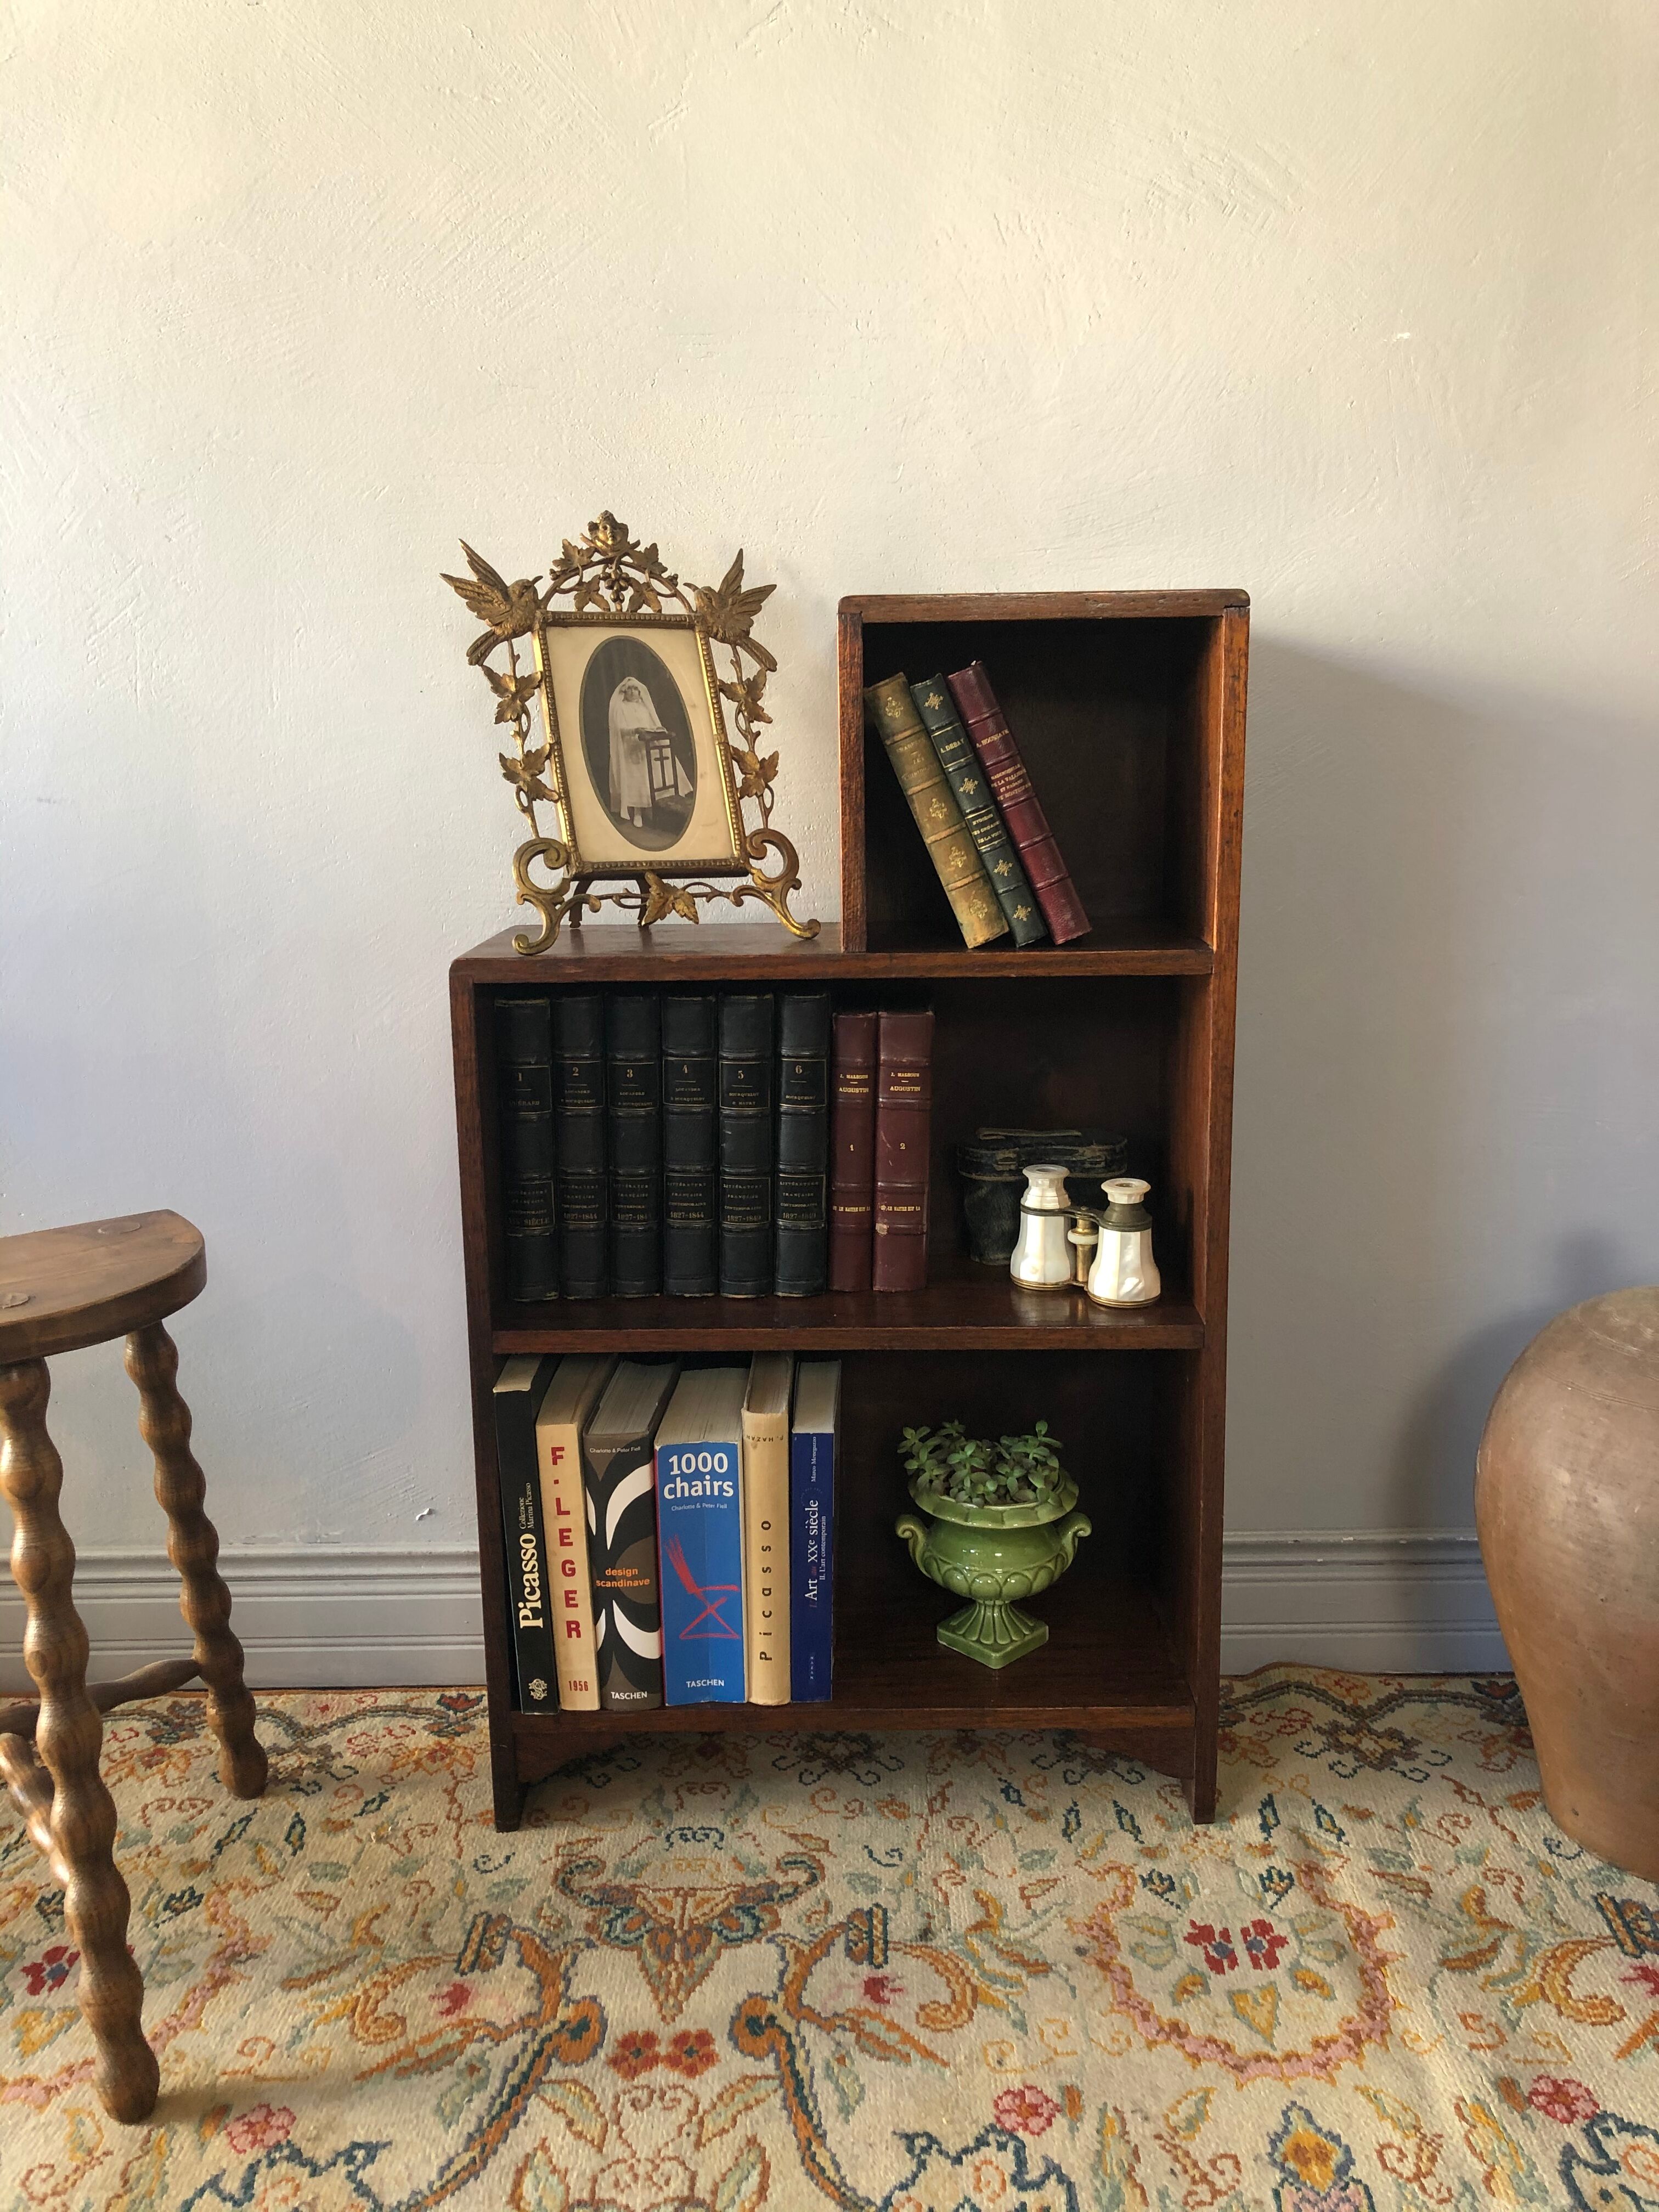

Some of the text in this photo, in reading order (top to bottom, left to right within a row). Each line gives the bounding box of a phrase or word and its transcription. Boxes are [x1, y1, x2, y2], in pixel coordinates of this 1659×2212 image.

[572, 1066, 579, 1076] 2
[627, 1068, 633, 1079] 3
[738, 1070, 744, 1080] 5
[795, 1064, 803, 1075] 6
[517, 1072, 522, 1082] 1
[900, 1142, 906, 1150] 2
[670, 1210, 704, 1219] 1827-1844
[668, 1452, 728, 1475] 1000
[663, 1474, 734, 1499] chairs
[518, 1497, 527, 1530] Collezione
[526, 1506, 535, 1530] Marina
[804, 1500, 818, 1536] siècle
[605, 1567, 639, 1577] design
[518, 1533, 544, 1629] Picasso
[596, 1578, 650, 1588] scandinave
[759, 1520, 772, 1661] Picasso
[568, 1680, 589, 1691] 1956
[686, 1679, 724, 1689] TASCHEN
[611, 1691, 647, 1700] TASCHEN
